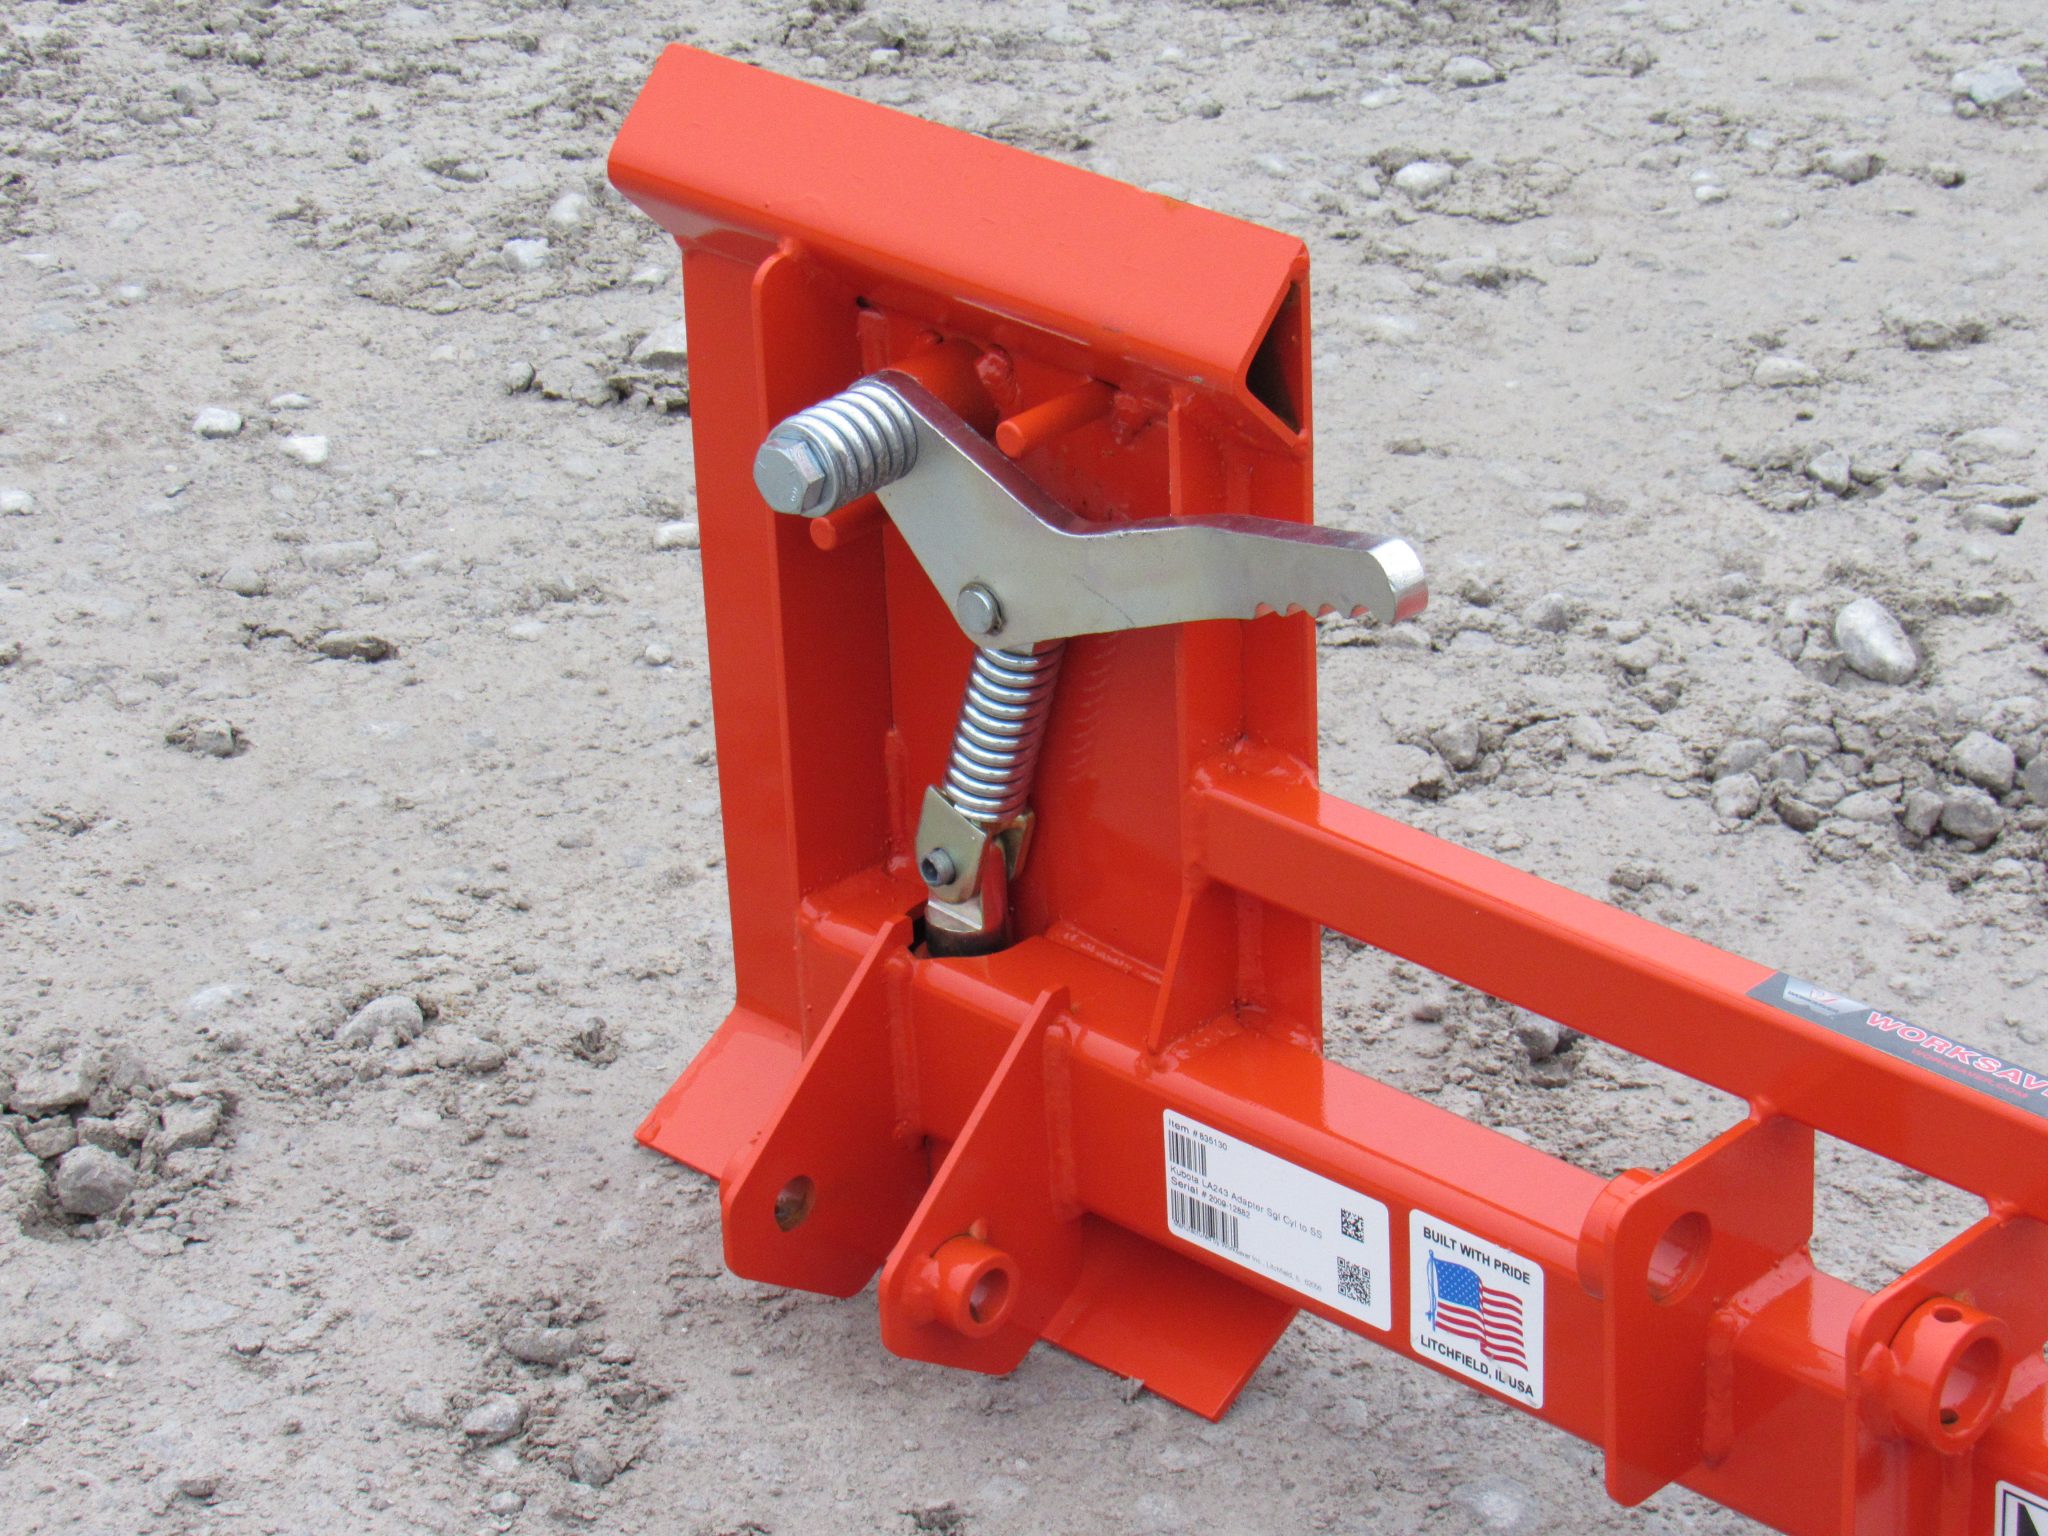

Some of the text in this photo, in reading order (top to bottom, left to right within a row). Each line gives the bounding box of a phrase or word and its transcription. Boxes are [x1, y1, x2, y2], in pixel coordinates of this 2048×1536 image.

[1866, 1010, 2048, 1097] WORKSAV
[1168, 1118, 1190, 1134] Item
[1170, 1165, 1199, 1184] Kubota
[1202, 1179, 1229, 1197] LA243
[1171, 1176, 1199, 1195] Serial
[1423, 1226, 1531, 1285] BUILT WITH PRIDE
[1420, 1334, 1534, 1398] LITCHFIELD, IL USA
